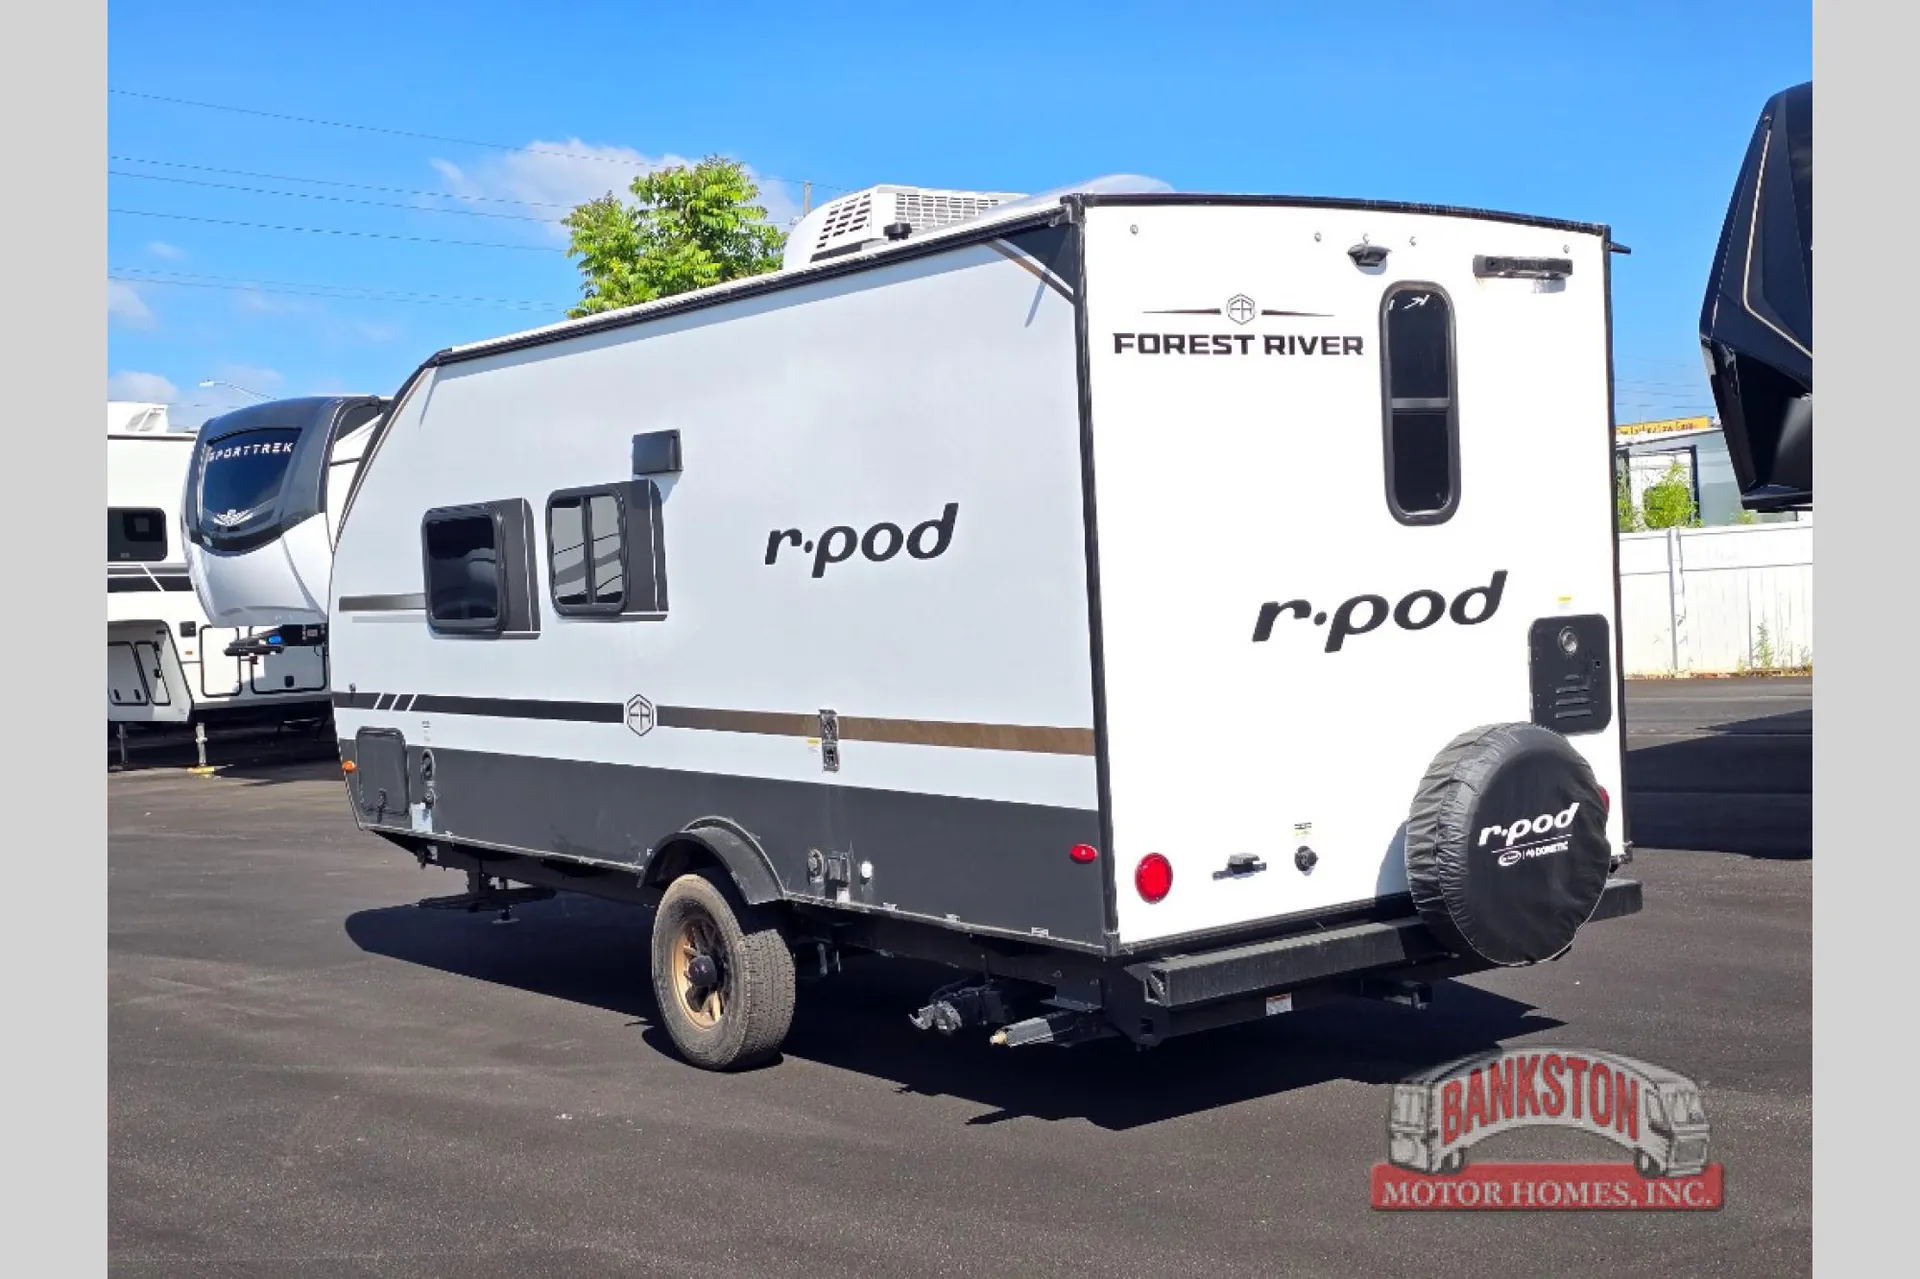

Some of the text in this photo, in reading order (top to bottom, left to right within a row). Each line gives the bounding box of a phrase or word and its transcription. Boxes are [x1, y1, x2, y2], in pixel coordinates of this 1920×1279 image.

[1113, 332, 1364, 356] FOREST RIVER
[208, 442, 294, 462] SPORTTREK
